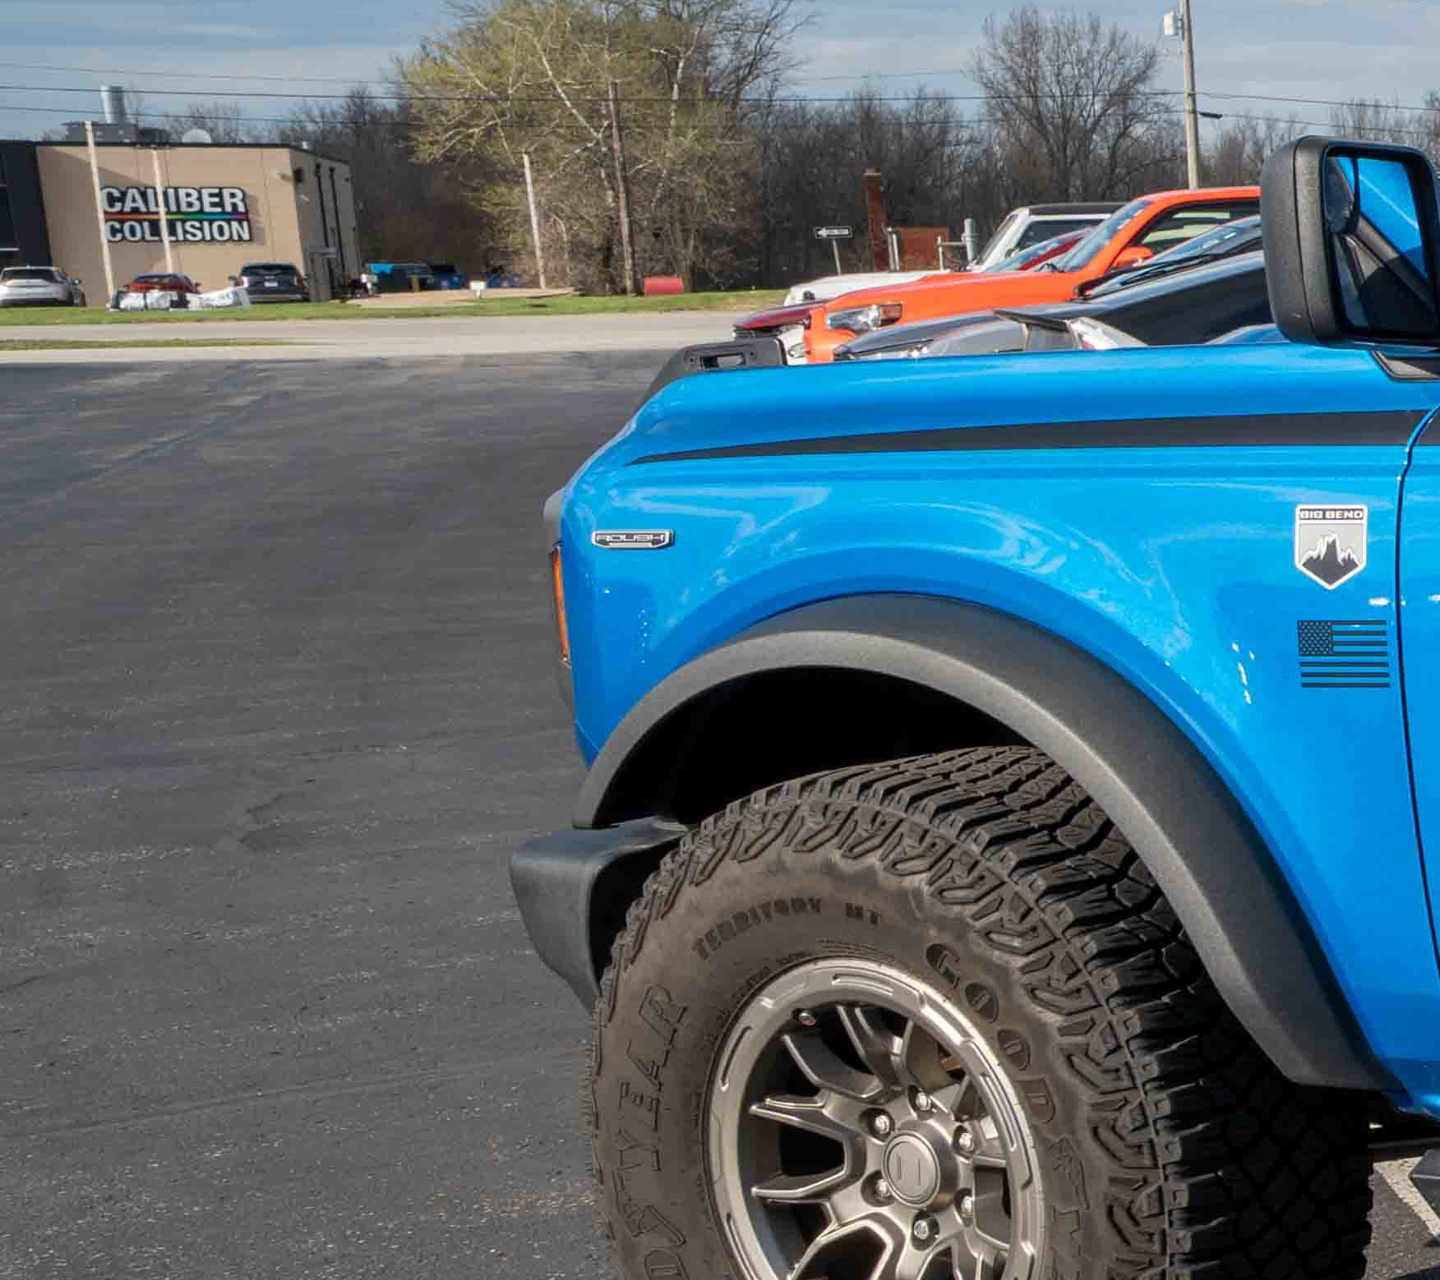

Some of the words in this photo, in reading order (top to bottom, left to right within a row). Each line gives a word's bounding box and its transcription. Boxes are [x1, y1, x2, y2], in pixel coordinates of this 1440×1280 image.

[101, 187, 246, 213] CALIBER
[105, 220, 251, 242] COLLISION
[1300, 509, 1324, 519] BIG
[1325, 509, 1363, 519] BEND
[691, 896, 823, 961] TERRITORY
